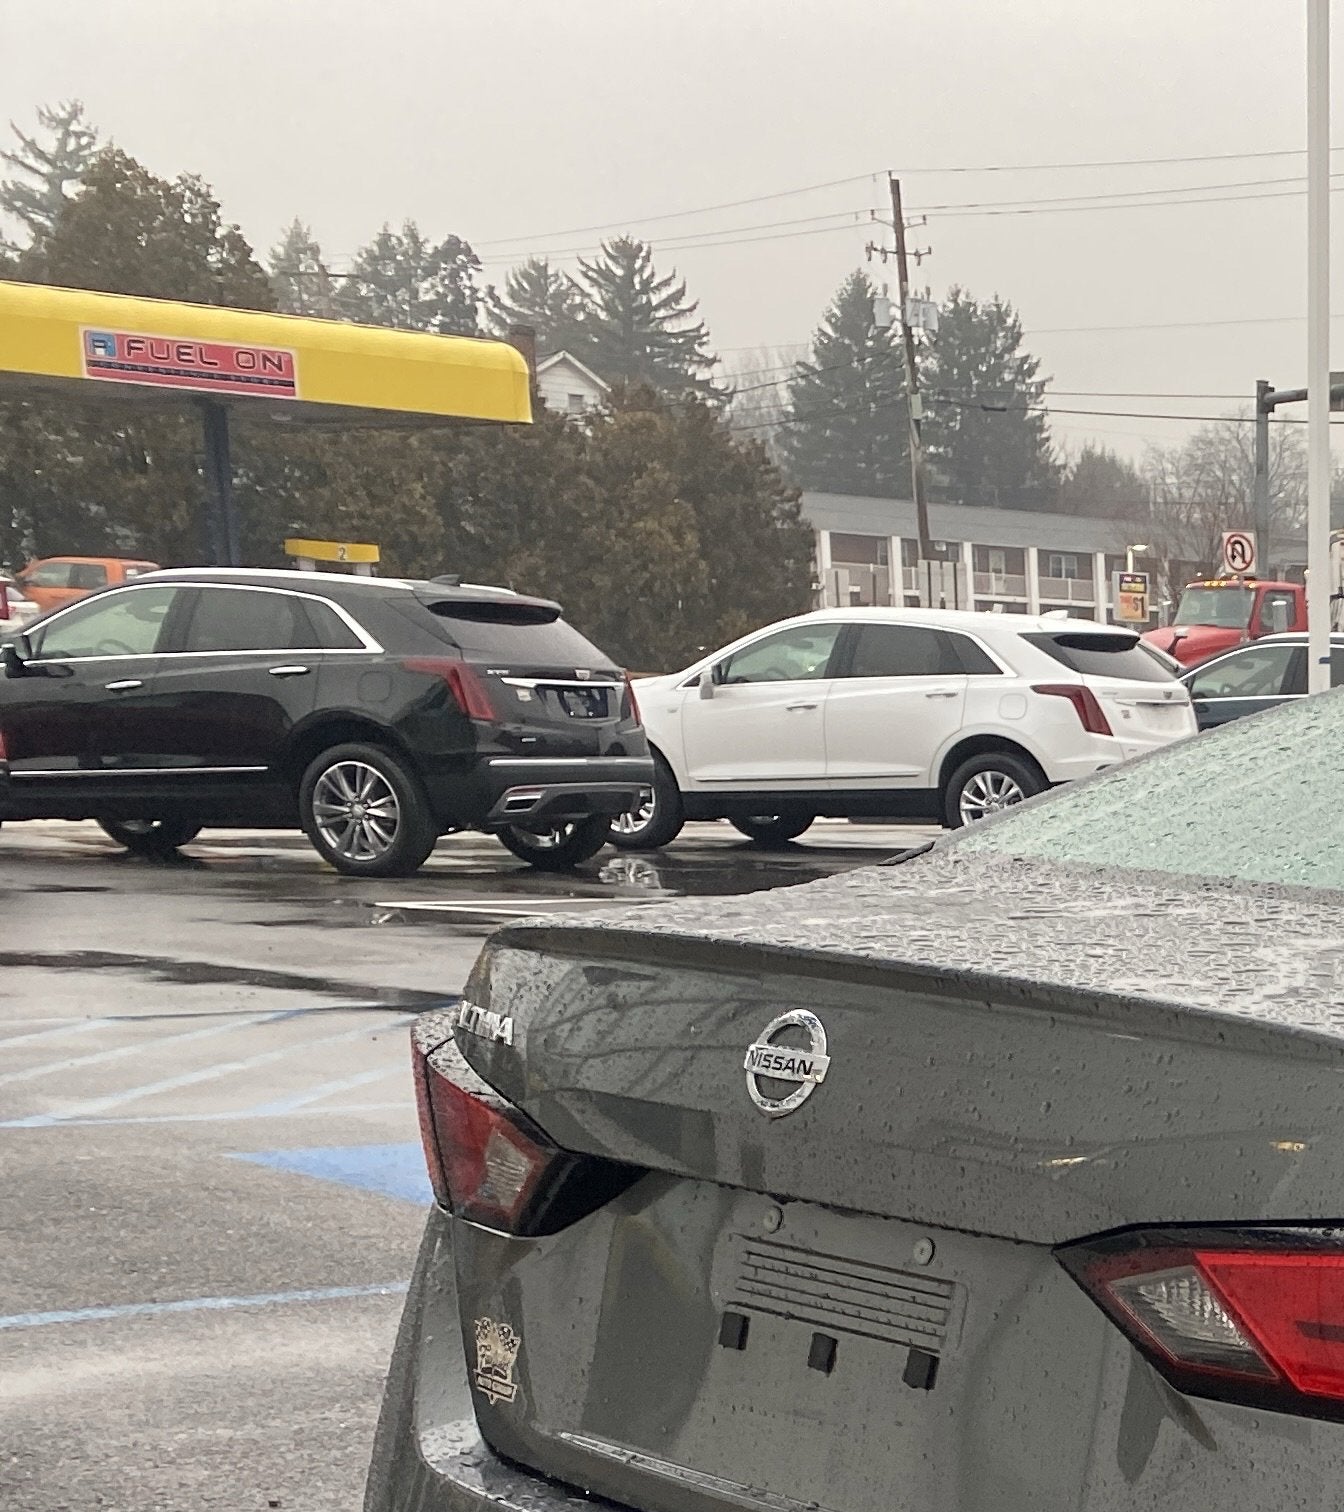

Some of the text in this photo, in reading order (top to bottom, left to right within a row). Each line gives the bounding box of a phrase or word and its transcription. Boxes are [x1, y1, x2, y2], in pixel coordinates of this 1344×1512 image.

[126, 338, 284, 373] FUEL ON
[749, 1049, 814, 1077] NISSAN
